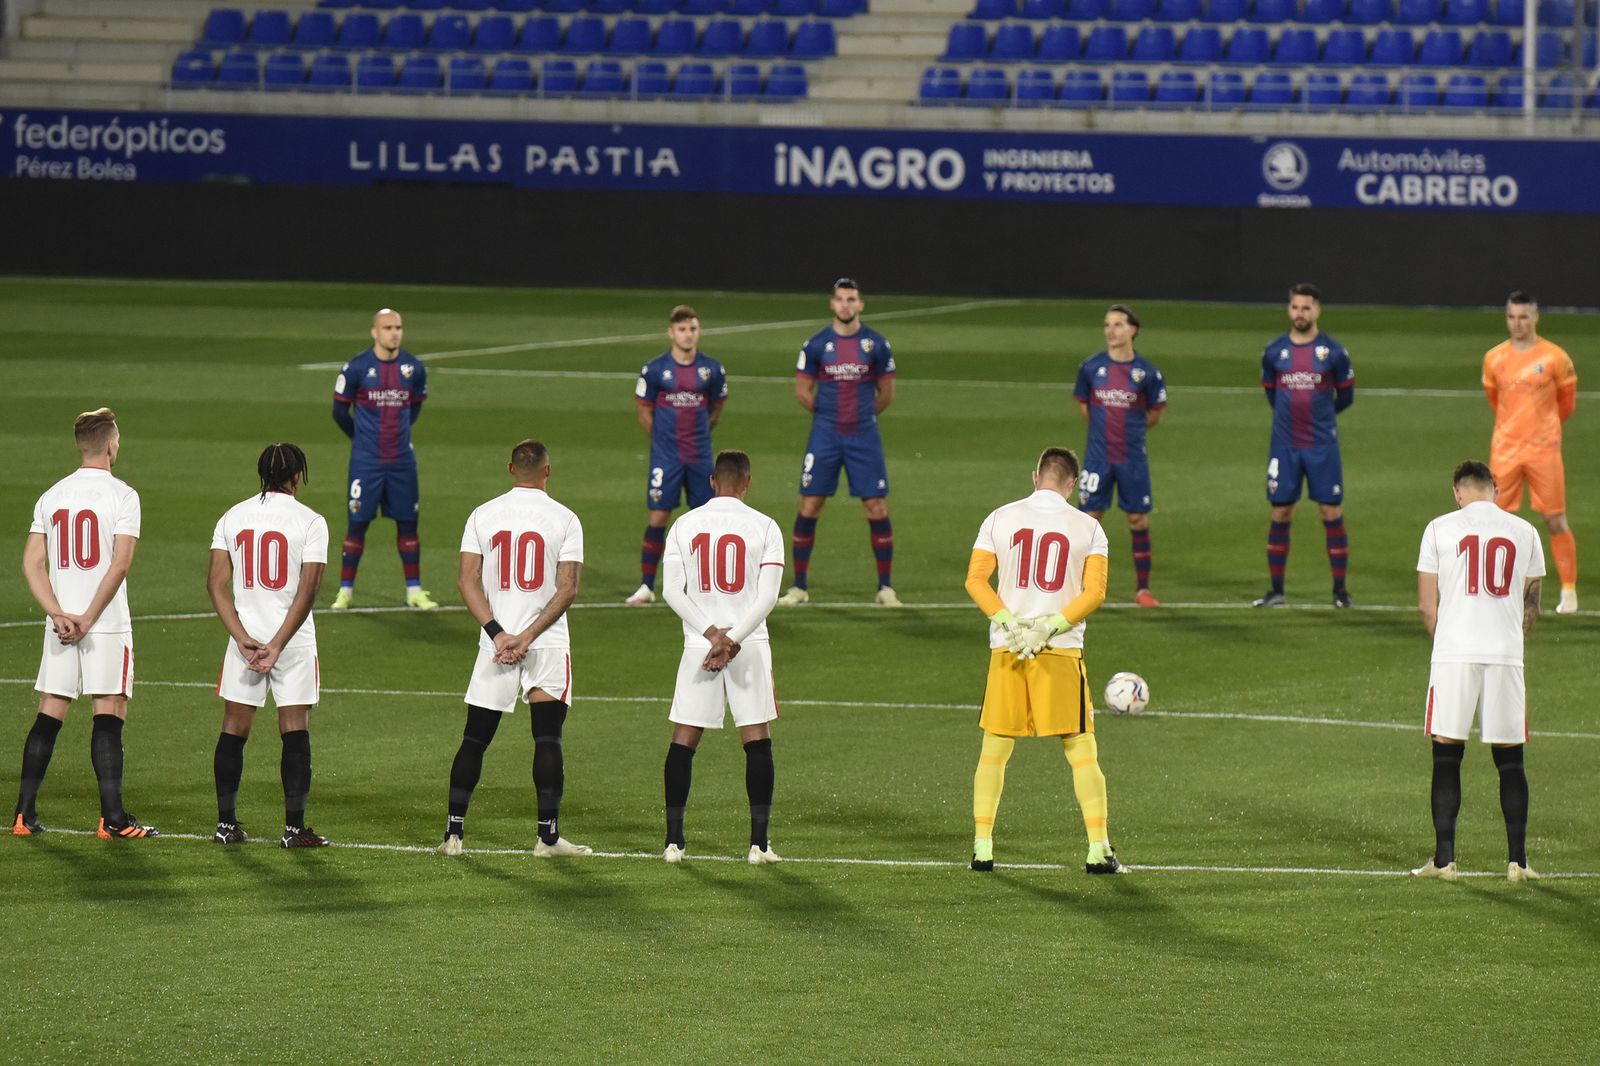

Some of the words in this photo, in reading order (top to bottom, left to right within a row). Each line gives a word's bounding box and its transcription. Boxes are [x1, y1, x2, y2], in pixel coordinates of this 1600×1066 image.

[14, 114, 226, 158] federópticos
[15, 155, 73, 178] Pérez
[76, 156, 137, 181] Bolea
[349, 140, 502, 172] LILLAS
[525, 145, 680, 177] PASTIA
[1338, 148, 1486, 174] Automóviles
[983, 172, 998, 191] Y
[1001, 173, 1115, 193] PROYECTOS
[1355, 174, 1519, 207] CABRERO
[651, 467, 664, 488] 3
[1268, 457, 1279, 479] 4
[350, 479, 362, 499] 6
[50, 508, 100, 570] 10
[234, 529, 289, 591] 10
[489, 530, 545, 592] 10
[690, 532, 746, 594] 10
[1009, 528, 1070, 593] 10
[1456, 535, 1516, 598] 10
